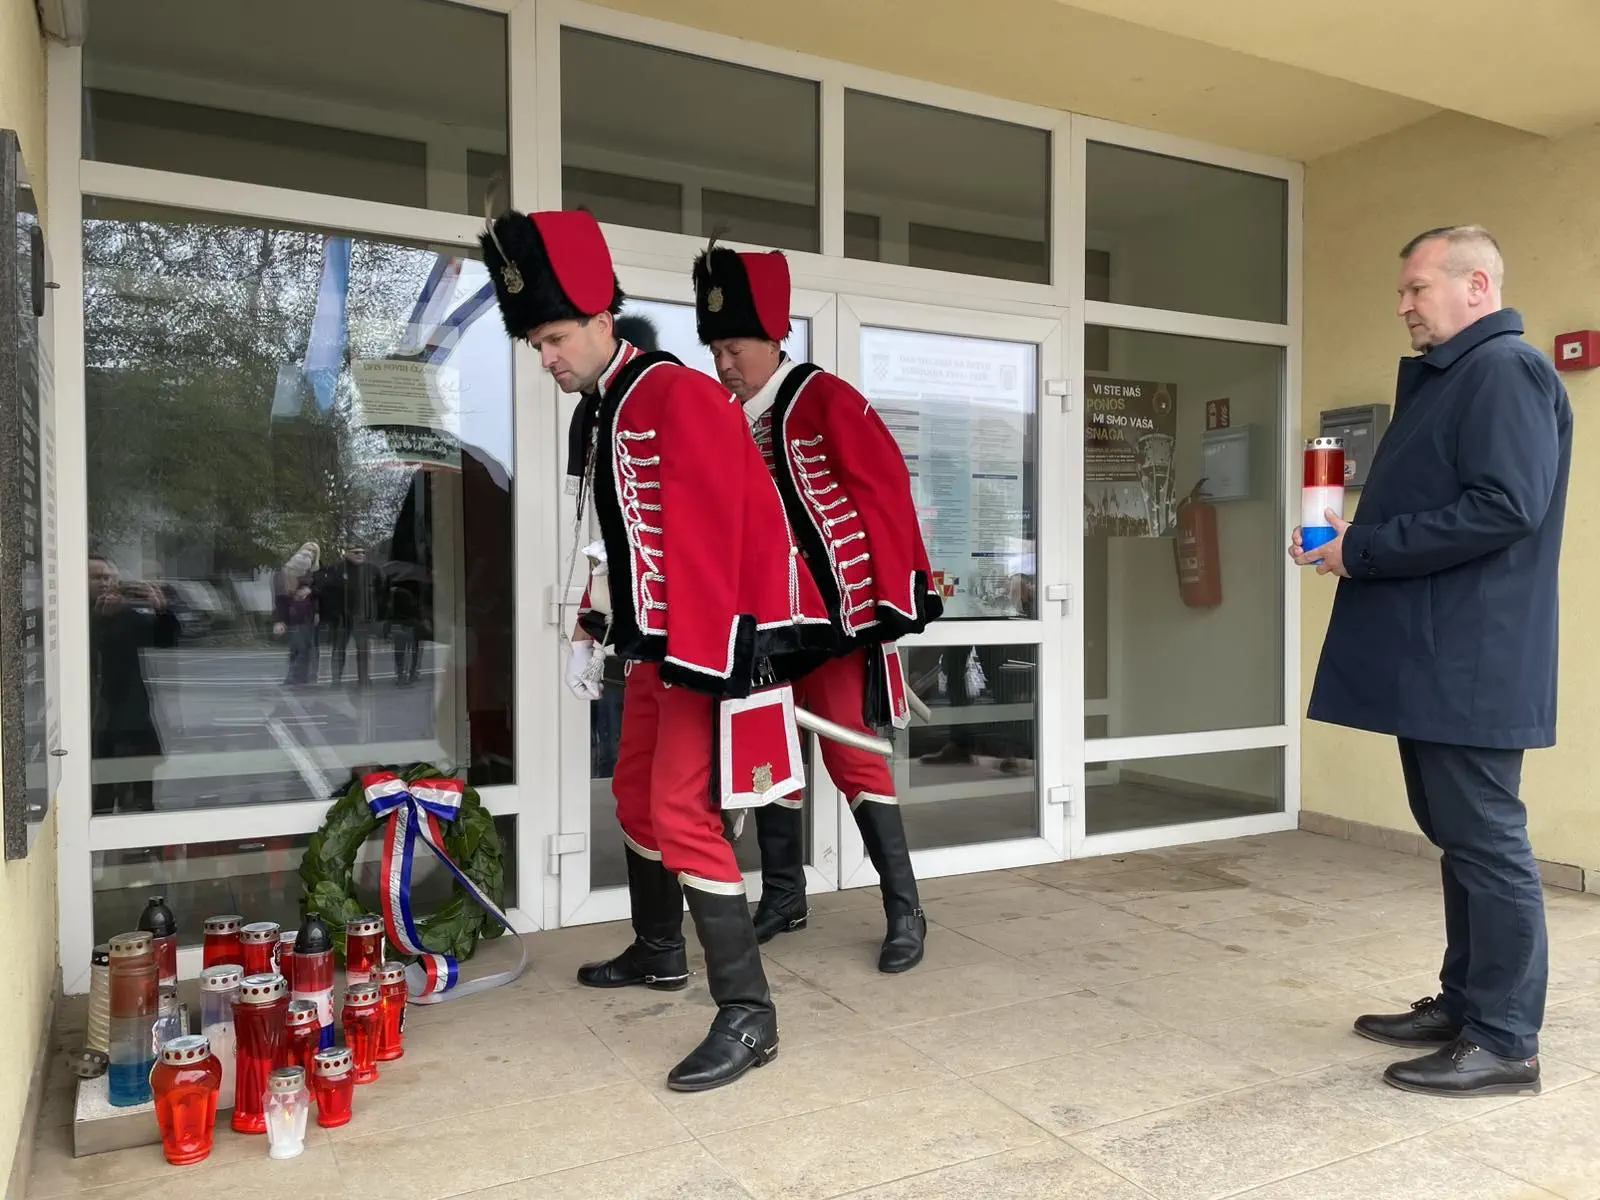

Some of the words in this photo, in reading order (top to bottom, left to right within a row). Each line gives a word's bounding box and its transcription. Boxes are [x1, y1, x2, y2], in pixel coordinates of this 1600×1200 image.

[1093, 384, 1102, 395] VI
[1104, 385, 1121, 396] STE
[1087, 398, 1125, 411] PONOS
[1093, 413, 1104, 424] MI
[1106, 415, 1127, 426] SMO
[1130, 417, 1153, 429] VAŠA
[1087, 428, 1124, 440] SNAGA
